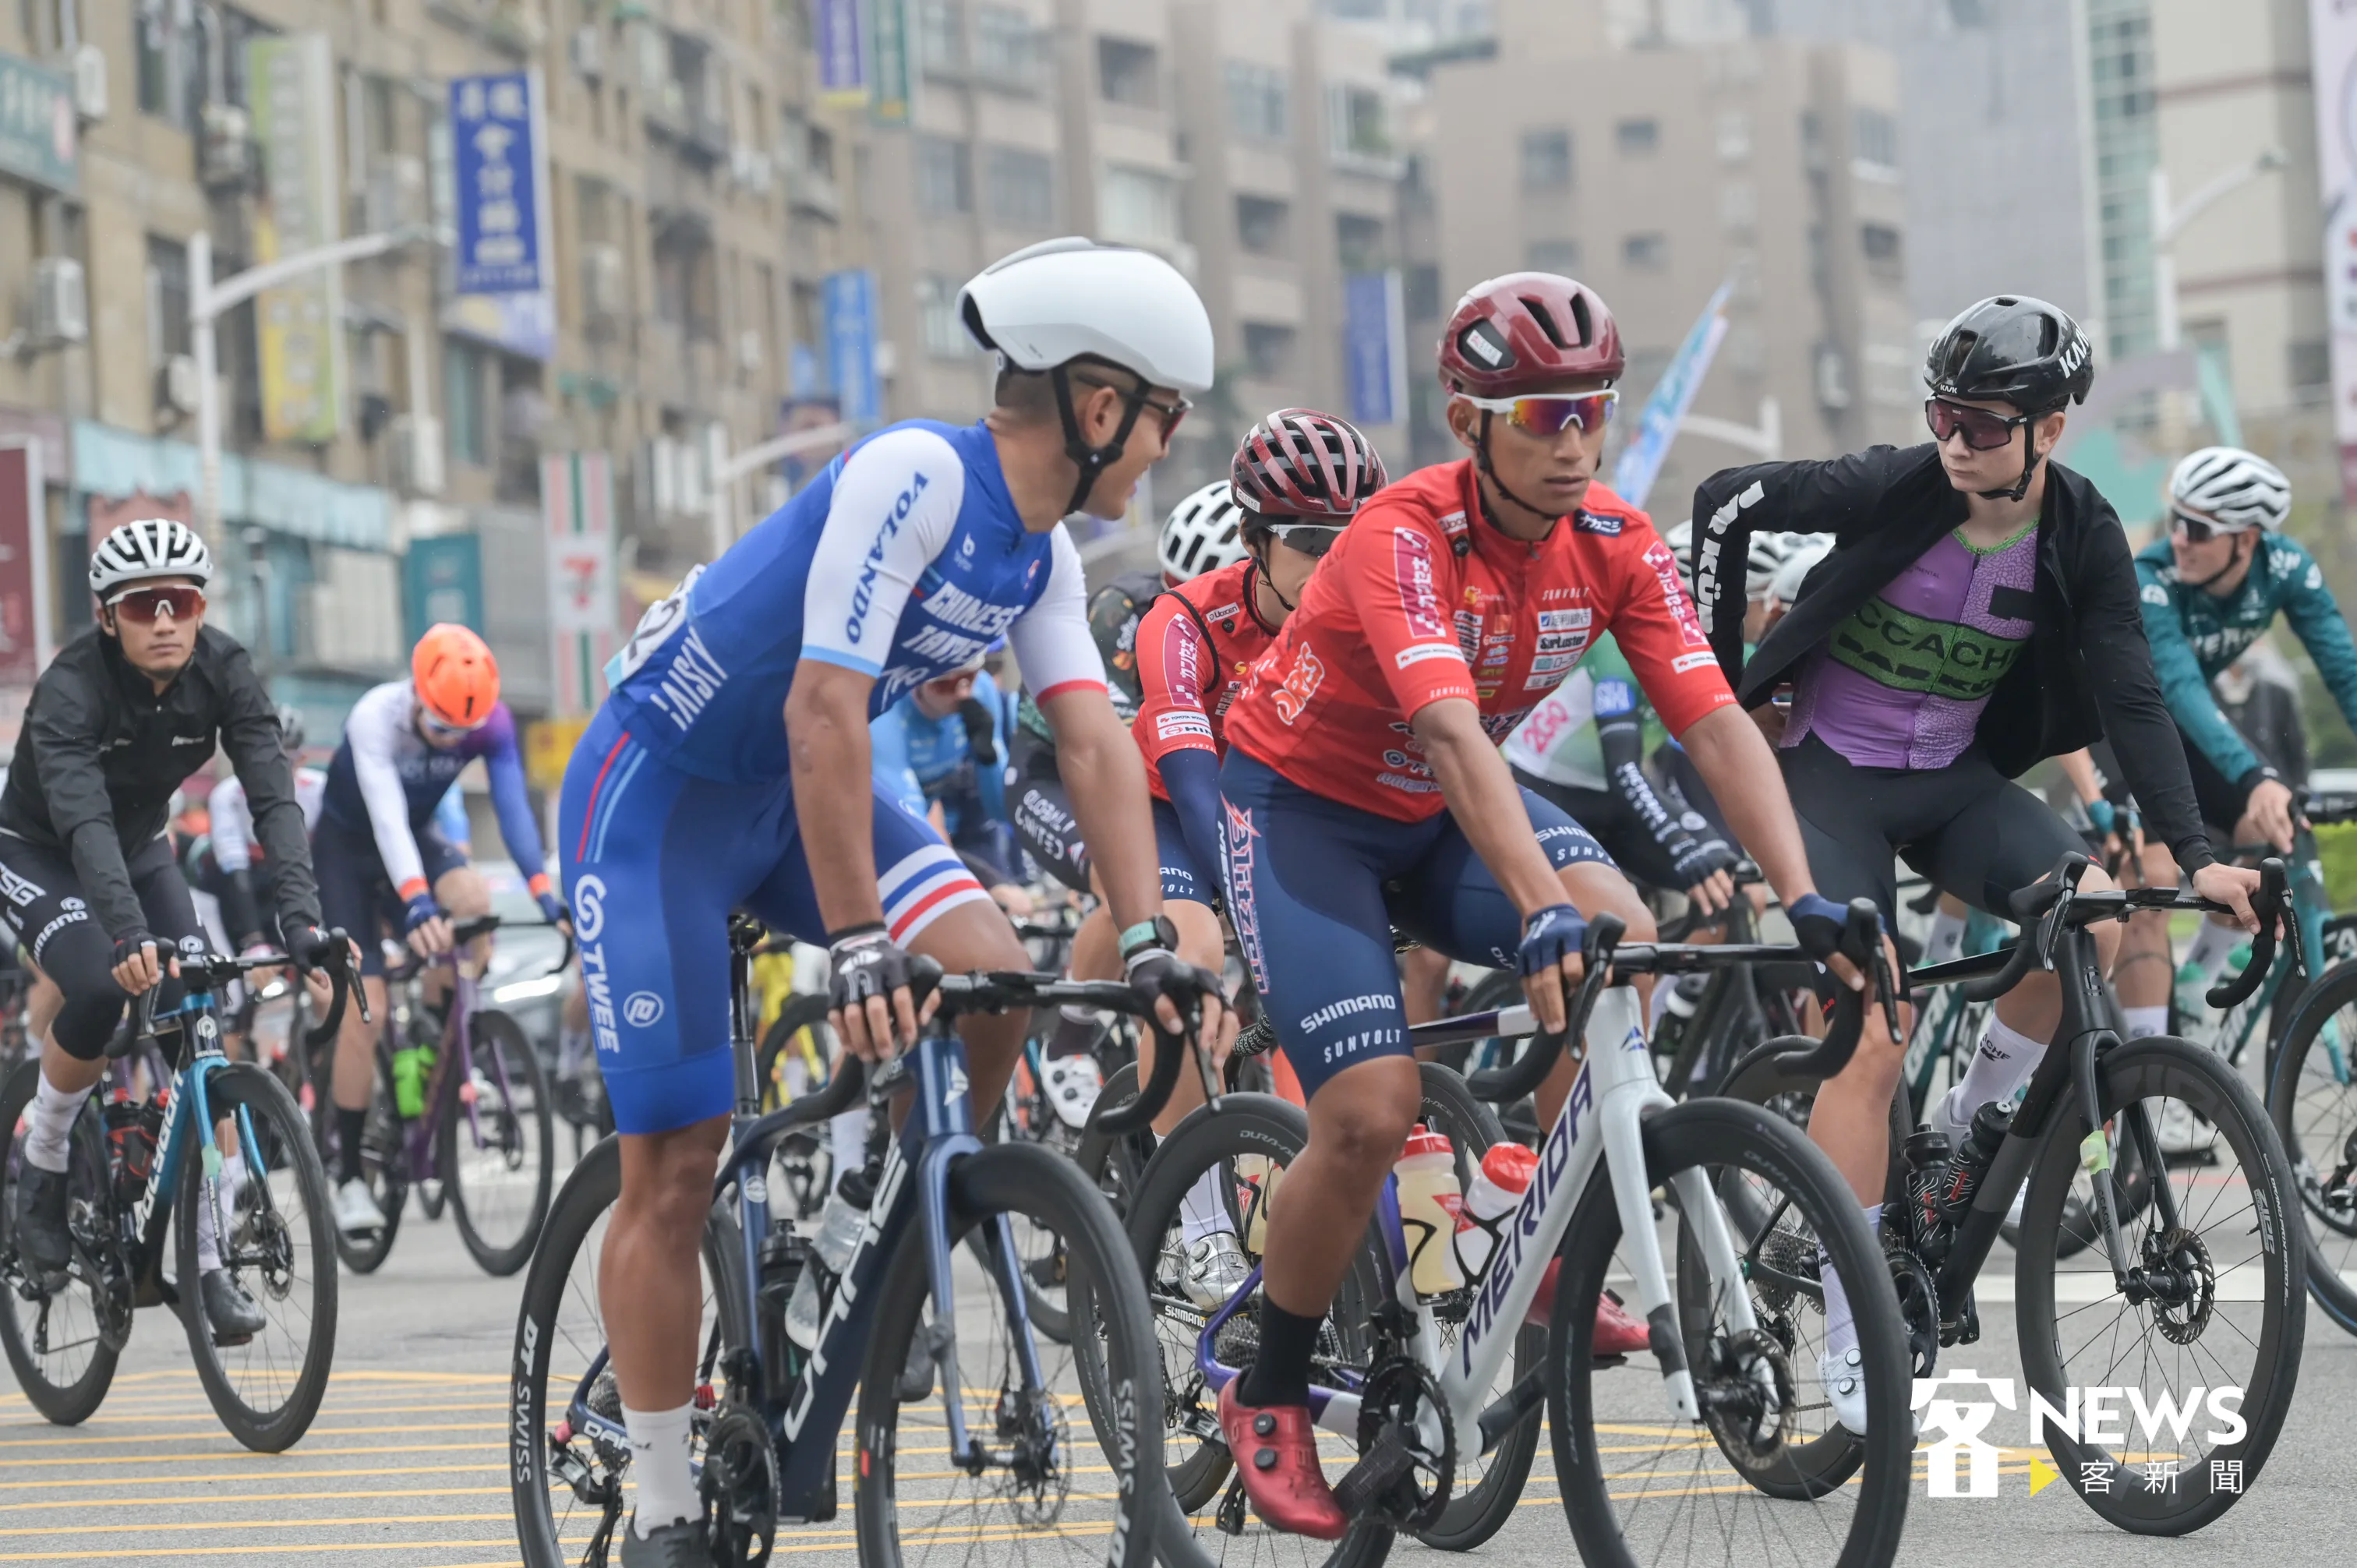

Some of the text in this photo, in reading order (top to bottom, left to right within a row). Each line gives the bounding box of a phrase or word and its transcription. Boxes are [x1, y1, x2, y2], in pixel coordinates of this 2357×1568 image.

[1939, 383, 1958, 394] KASK
[846, 471, 929, 645] VOLANDO
[921, 580, 1025, 637] CHINESE
[1540, 634, 1586, 650] SurLuster
[2289, 910, 2302, 961] DURA-ACE
[583, 941, 620, 1054] TWEE
[1299, 994, 1397, 1034] SHIMANO
[1323, 1028, 1401, 1064] SUNVOLT
[136, 1070, 183, 1243] POLYGON
[1462, 1065, 1592, 1380] MERIDA
[2097, 1188, 2113, 1236] CCACHE
[2260, 1188, 2276, 1255] ZIPP
[2270, 1177, 2283, 1217] GRAND
[2279, 1217, 2288, 1248] PRIX
[1164, 1305, 1206, 1328] SHIMANO
[515, 1314, 539, 1484] DT SWISS
[1117, 1378, 1136, 1496] SWISS
